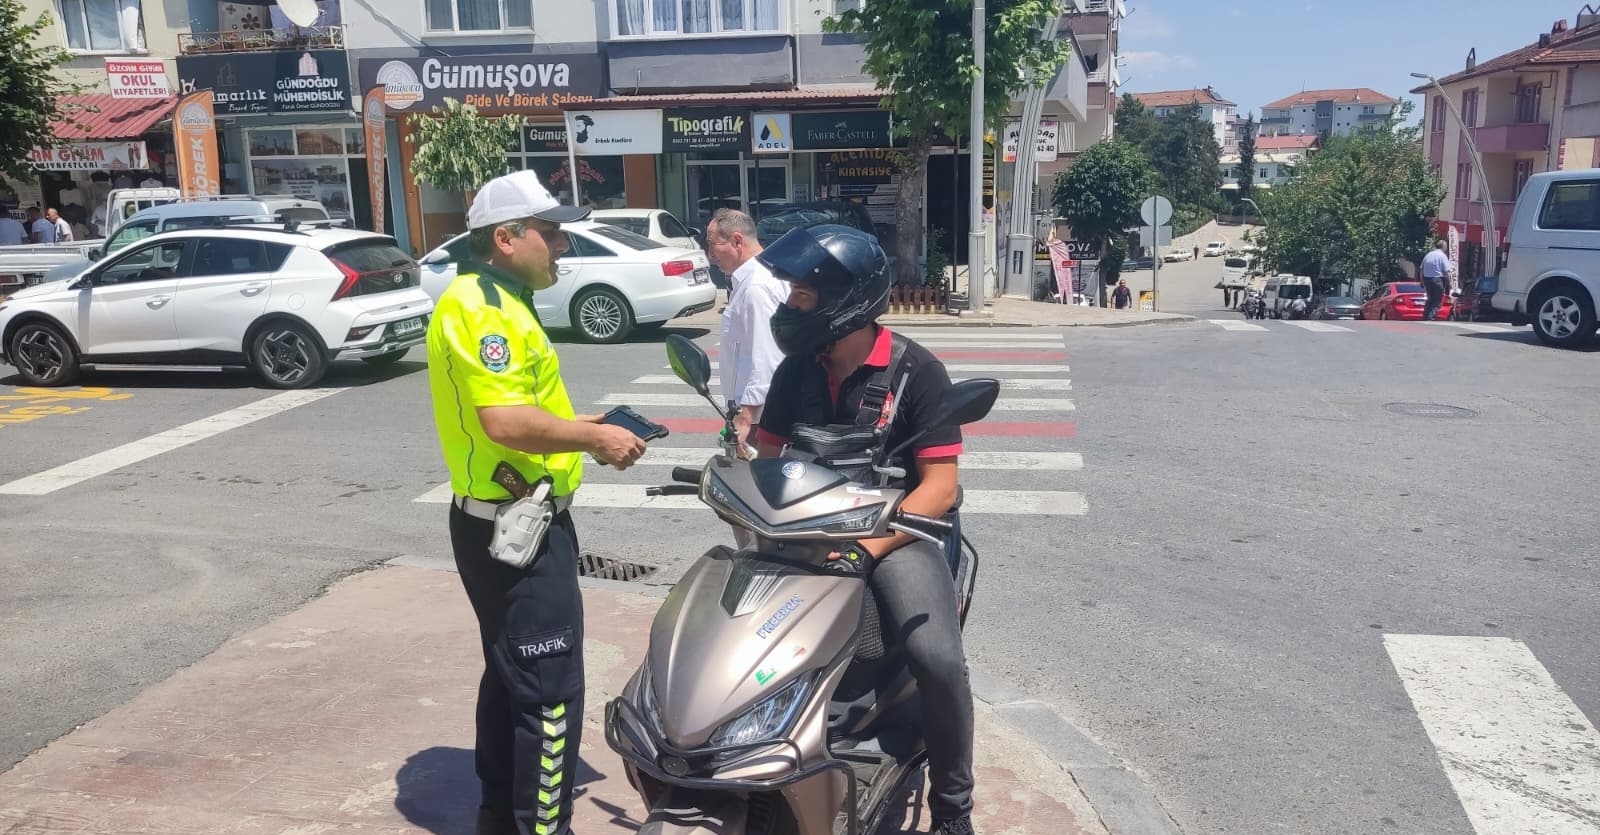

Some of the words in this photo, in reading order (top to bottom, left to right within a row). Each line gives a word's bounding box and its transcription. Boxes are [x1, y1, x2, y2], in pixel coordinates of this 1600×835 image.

[109, 63, 137, 72] ÖZCAN
[121, 75, 156, 86] OKUL
[276, 76, 338, 90] GÜNDOĞDU
[422, 58, 570, 97] Gümüşova
[113, 87, 167, 96] KIYAFETLERİ
[273, 88, 345, 103] MÜHENDİSLİK
[466, 94, 491, 107] Pide
[496, 94, 511, 107] Ve
[513, 93, 548, 107] Börek
[668, 115, 744, 136] Tipografik
